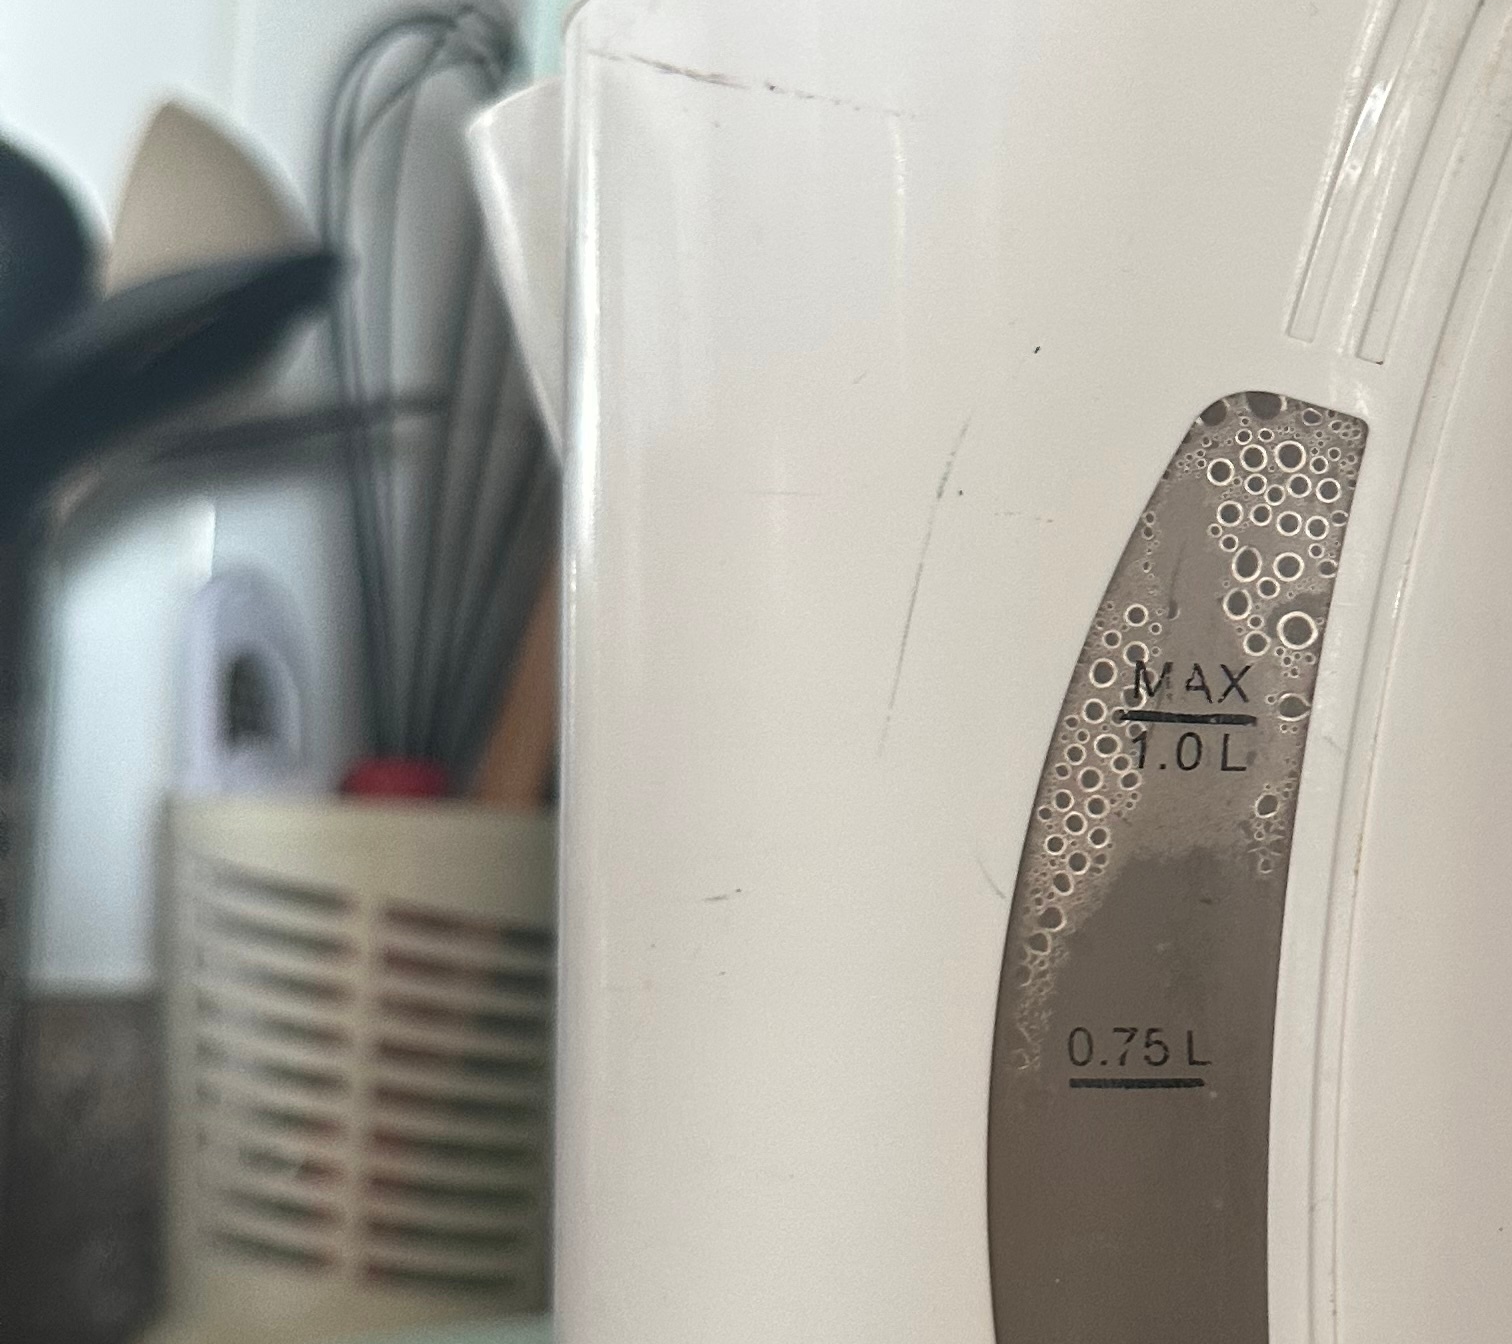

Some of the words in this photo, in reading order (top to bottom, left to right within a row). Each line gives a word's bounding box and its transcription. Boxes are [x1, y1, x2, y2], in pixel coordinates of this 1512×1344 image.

[1132, 660, 1252, 703] MAX
[1131, 730, 1203, 771] 1.0
[1220, 732, 1248, 772] L
[1067, 1026, 1170, 1067] 0.75
[1186, 1029, 1212, 1066] L
